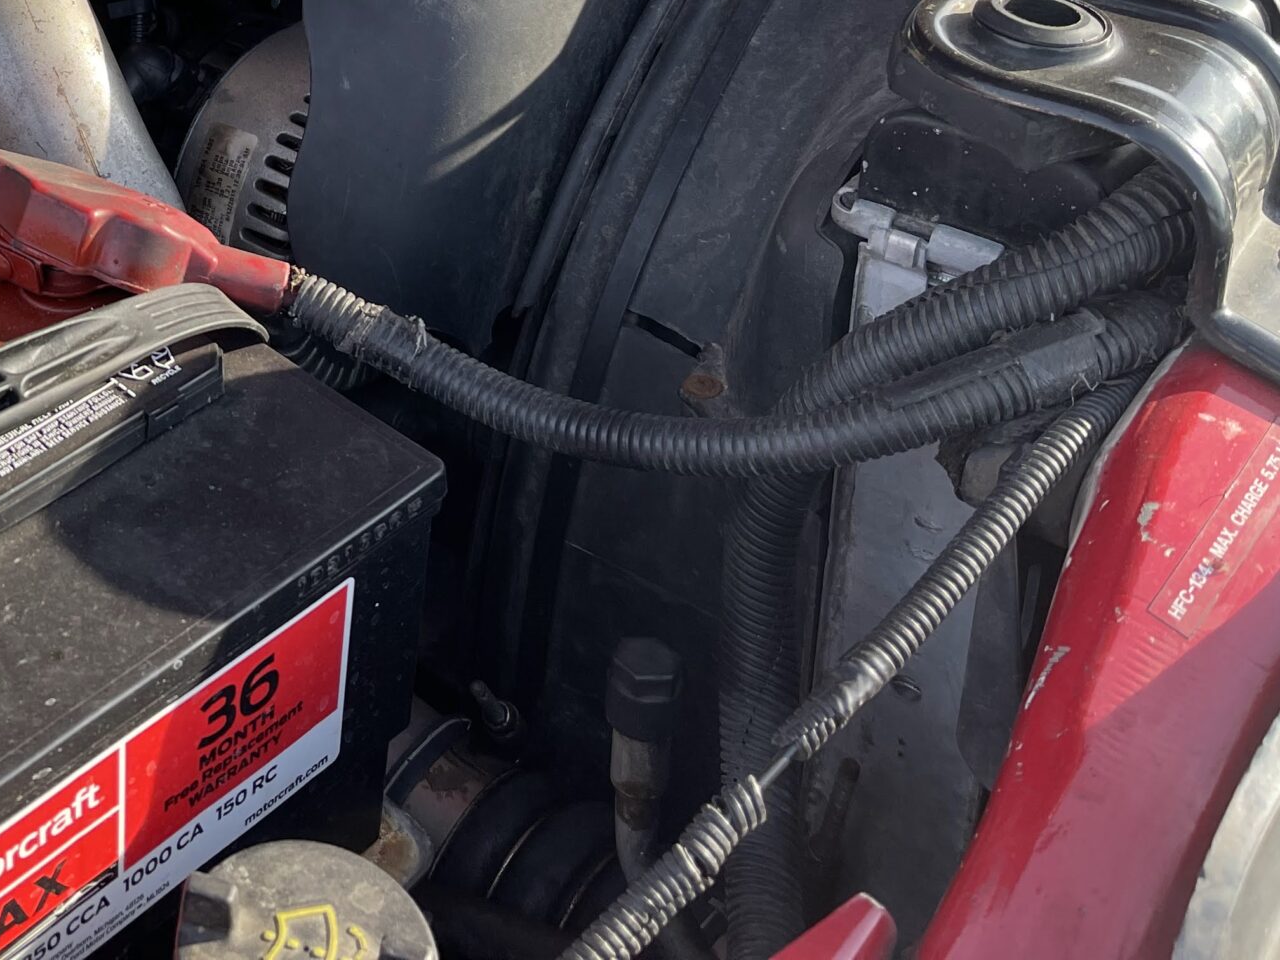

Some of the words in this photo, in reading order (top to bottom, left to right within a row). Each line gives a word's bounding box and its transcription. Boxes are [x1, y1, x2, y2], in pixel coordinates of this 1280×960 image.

[151, 365, 183, 386] RECYCLE
[1209, 527, 1239, 561] MAX.
[1230, 478, 1269, 527] CHARGE
[196, 653, 280, 750] 36
[198, 705, 275, 772] MONTH
[164, 778, 199, 813] Free
[201, 700, 304, 784] Replacement
[187, 732, 283, 809] WARRANTY
[244, 754, 329, 827] motorcraft.com
[66, 895, 111, 936] CCA
[123, 846, 172, 892] 1000
[176, 822, 205, 851] CA
[215, 788, 248, 821] 150
[251, 764, 278, 795] RC
